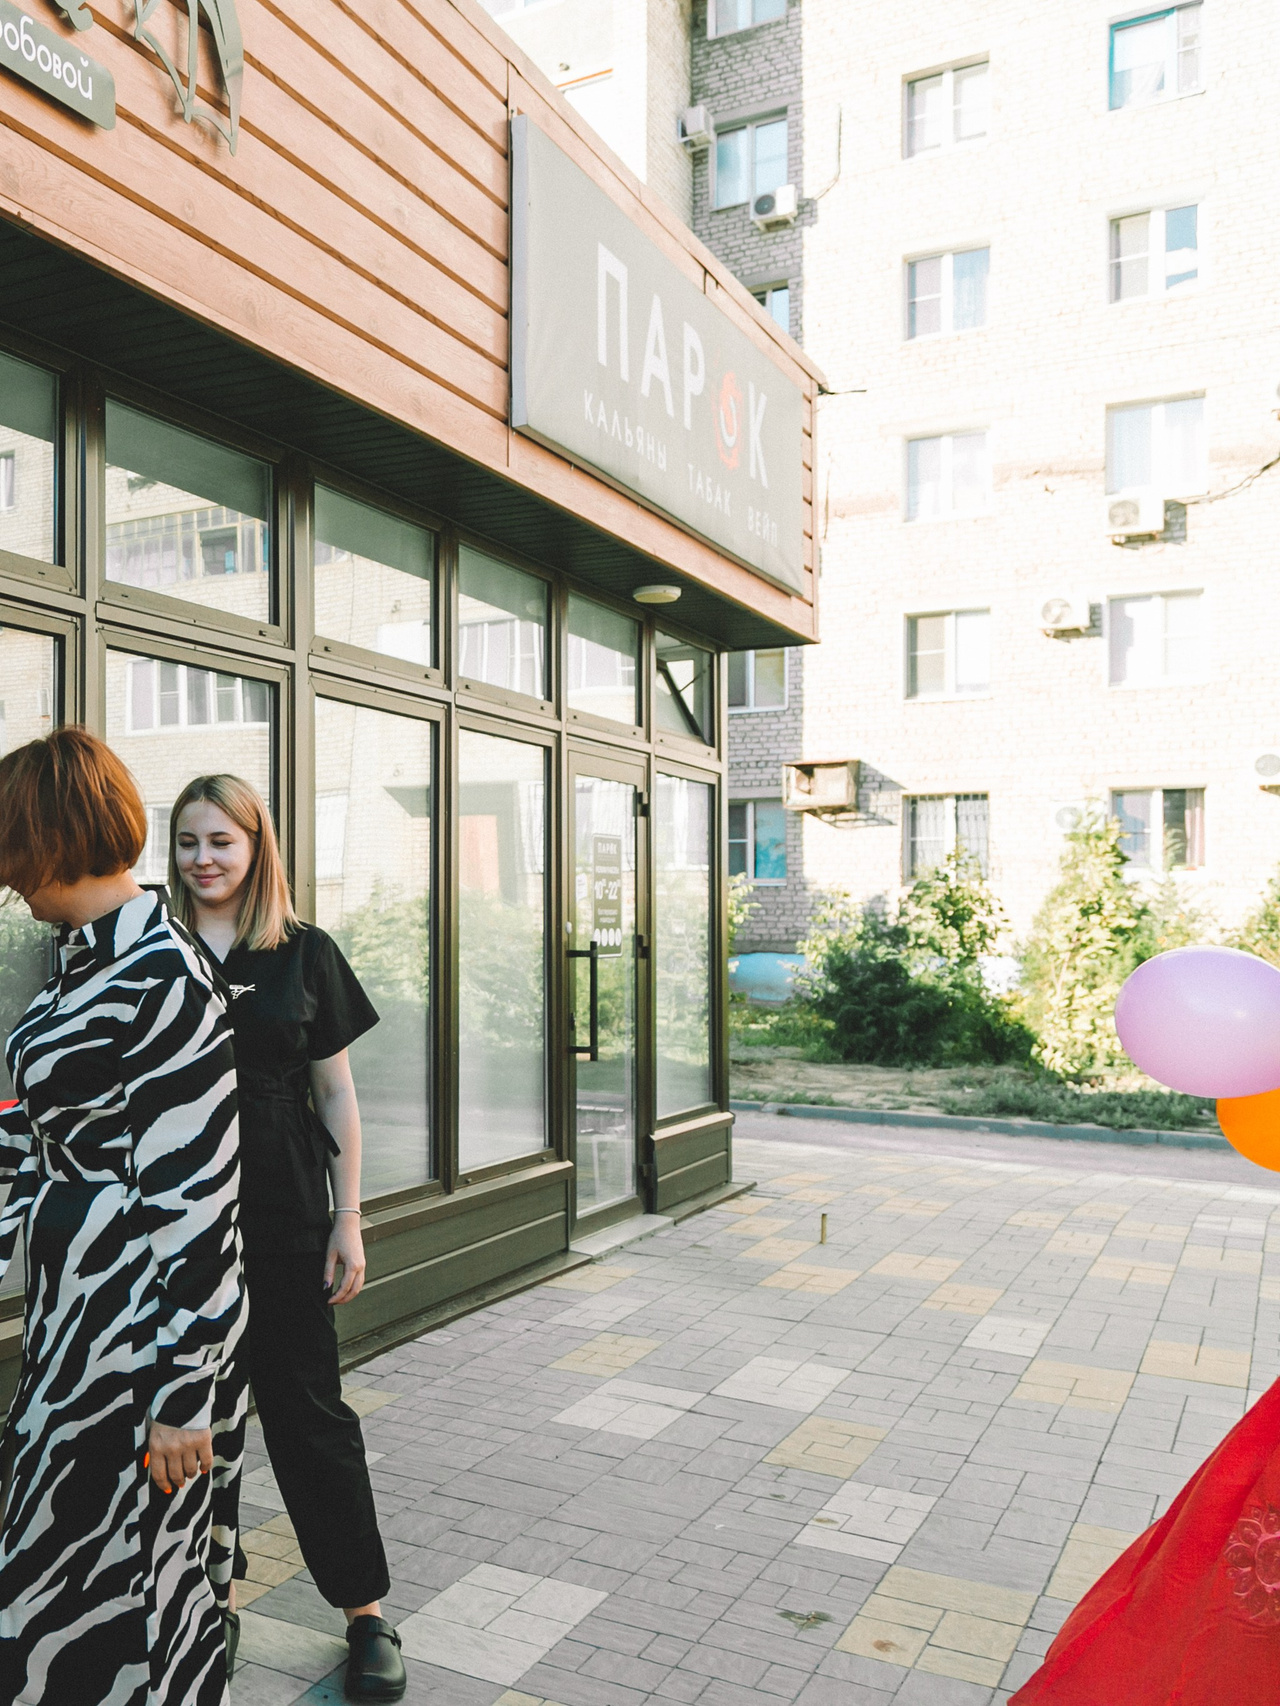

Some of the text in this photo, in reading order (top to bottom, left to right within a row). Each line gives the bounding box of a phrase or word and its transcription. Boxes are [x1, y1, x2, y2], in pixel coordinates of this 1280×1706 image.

[583, 388, 779, 549] КАЛЬЯНЫ ТАБАК ВЕЙП
